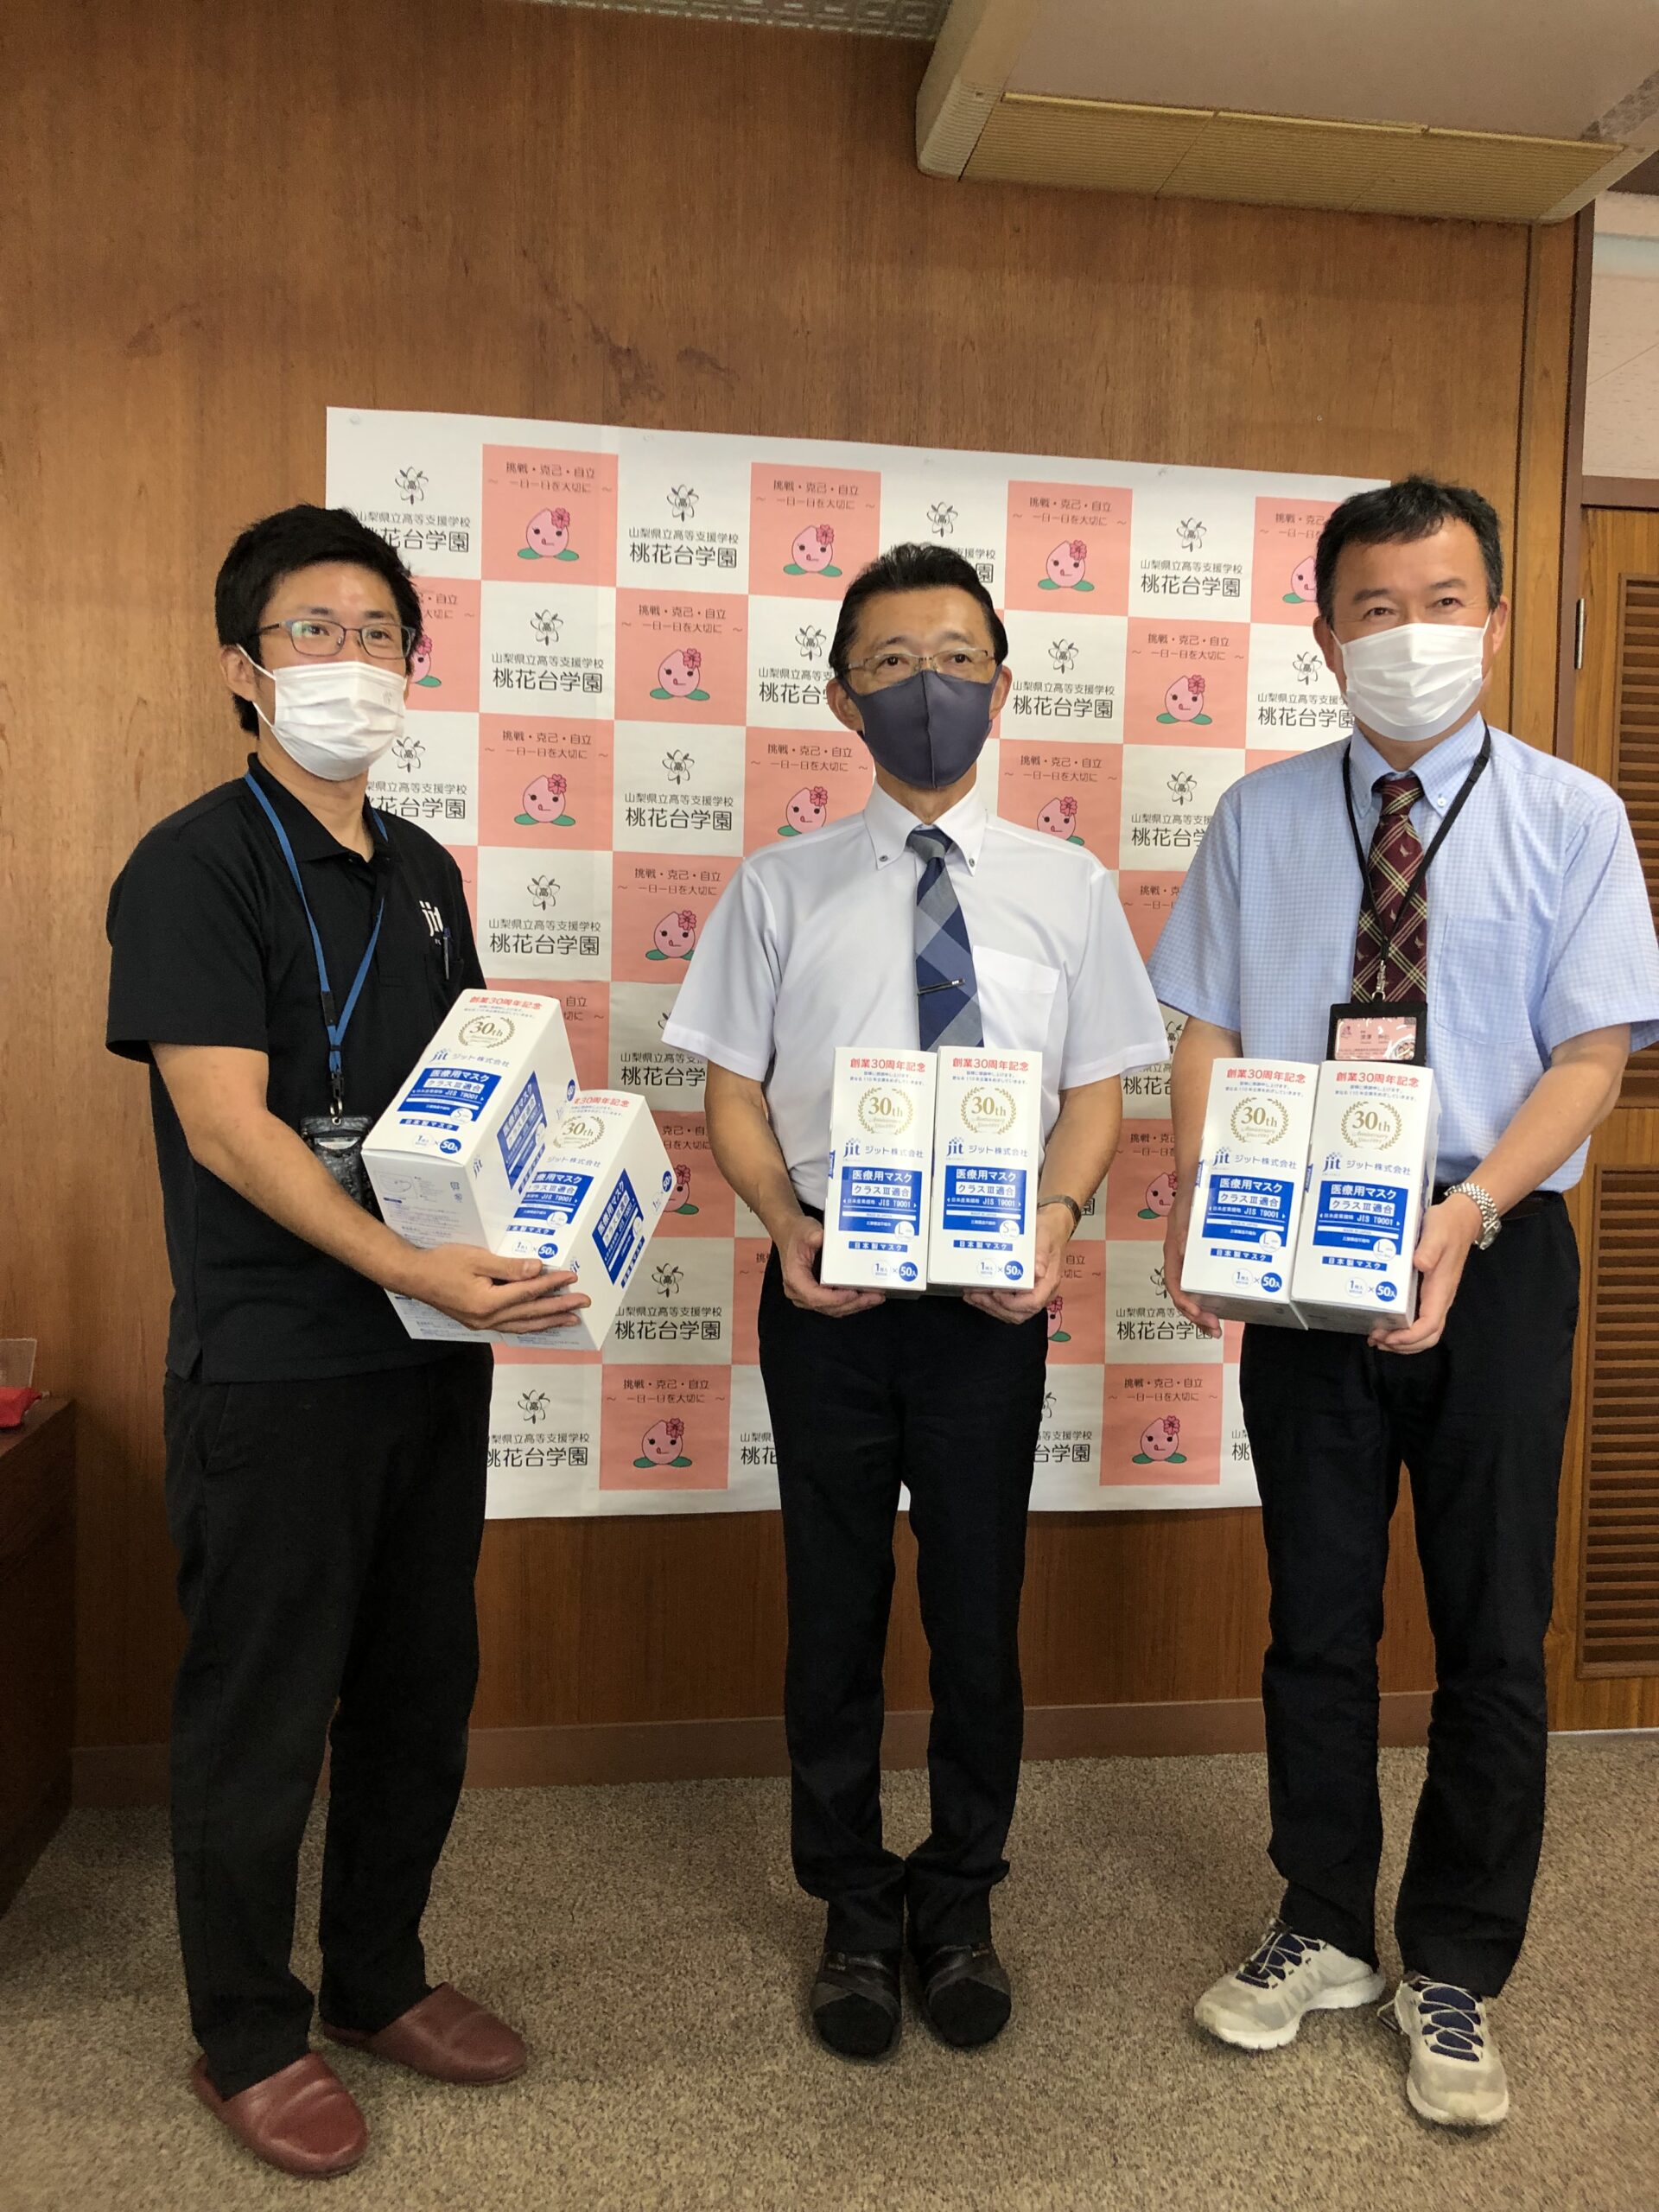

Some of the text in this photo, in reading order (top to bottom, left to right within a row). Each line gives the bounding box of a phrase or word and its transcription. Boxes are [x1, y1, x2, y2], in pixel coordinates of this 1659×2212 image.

[506, 461, 595, 479] 挑戦・克己・自立
[772, 479, 859, 496] 挑戦・克己・自立
[1029, 497, 1112, 513] 挑戦・克己・自立
[367, 528, 469, 553] 花台学園
[628, 527, 739, 544] 山梨県立高等支援学校
[629, 543, 737, 568] 桃花台学園
[1140, 559, 1243, 575] 山梨県立高等支援学校
[1141, 574, 1241, 597] 桃花台学園
[639, 605, 726, 620] 挑戦・克己・自立
[1147, 632, 1230, 648] 挑戦・克己・自立
[492, 653, 604, 670] 山梨県立高等支援学校
[493, 669, 602, 694] 桃花台学園
[1012, 681, 1116, 696] 山梨県立高等支援学校
[1013, 695, 1113, 719] 桃花台学園
[501, 730, 591, 746] 挑戦・克己・自立
[767, 743, 853, 759] 挑戦・克己・自立
[1020, 754, 1102, 770] 挑戦・克己・自立
[369, 795, 466, 819] 花台学園
[625, 792, 734, 809] 山梨県立高等支援学校
[626, 807, 732, 831] 桃花台学園
[634, 868, 721, 882] 挑戦・克己・自立
[488, 918, 601, 933] 山梨県立高等支援学校
[489, 933, 601, 957] 桃花台学園
[850, 1058, 925, 1072] 創業30周年記念
[952, 1058, 1029, 1071] 創業30周年記念
[1227, 1068, 1306, 1084] 創業30周年記念
[1336, 1071, 1419, 1088] 創業30周年記念
[868, 1096, 903, 1117] 30th
[971, 1096, 1007, 1116] 30th
[1241, 1107, 1278, 1128] 30th
[1352, 1110, 1390, 1132] 30th
[843, 1141, 924, 1158] jit ジット株式会社
[946, 1141, 1028, 1158] jit ジット株式会社
[1212, 1150, 1298, 1170] jit ジット株式会社
[1322, 1155, 1411, 1176] jit ジット株式会社
[852, 1169, 912, 1183] 医療用マスク
[956, 1168, 1016, 1182] 医療用マスク
[1219, 1178, 1283, 1193] 医療用マスク
[1331, 1184, 1397, 1200] 医療用マスク
[615, 1320, 721, 1340] 桃花台学園
[623, 1379, 709, 1390] 挑戦・克己・自立
[1124, 1377, 1203, 1389] 挑戦・克己・自立
